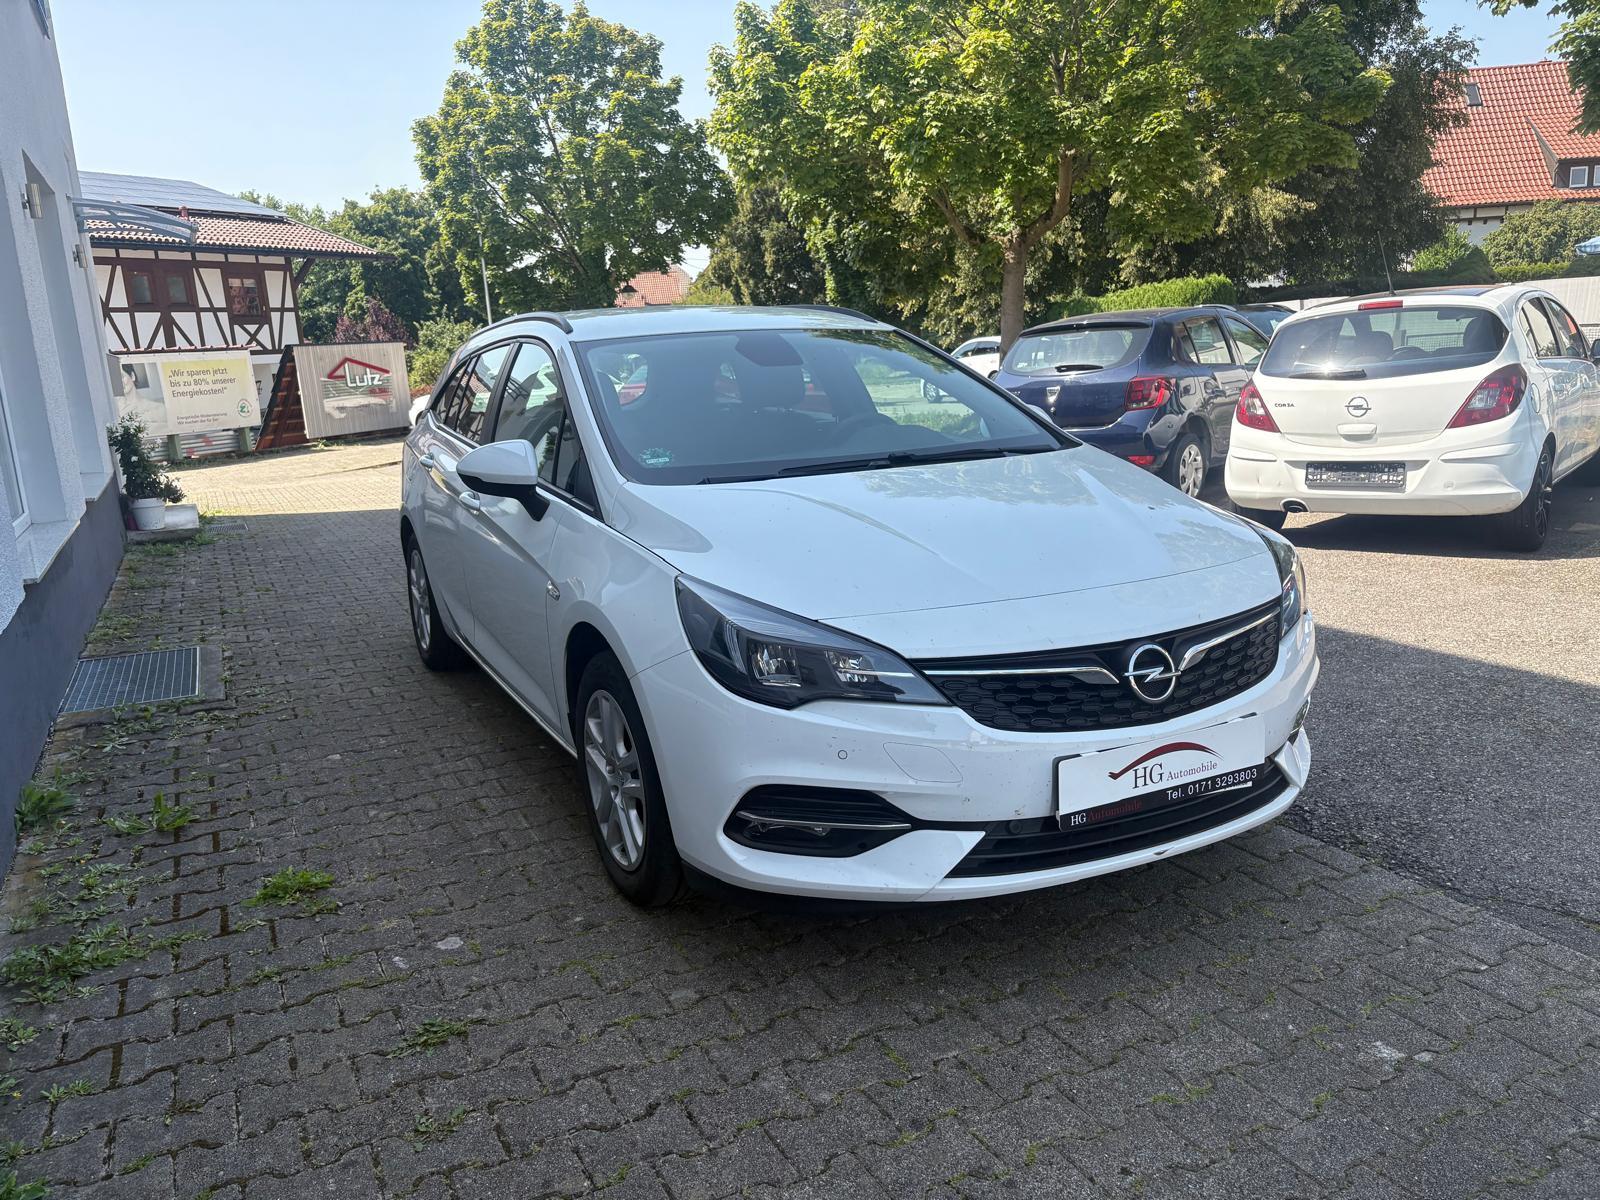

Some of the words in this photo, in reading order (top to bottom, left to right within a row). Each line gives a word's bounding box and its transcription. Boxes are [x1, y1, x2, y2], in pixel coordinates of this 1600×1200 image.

[186, 369, 211, 378] sparen
[212, 367, 228, 376] jetzt
[344, 363, 382, 387] Lutz
[169, 379, 181, 388] bis
[193, 378, 210, 386] 80%
[211, 377, 236, 385] unserer
[1132, 762, 1165, 789] HG
[1166, 761, 1218, 781] Automobile
[1166, 788, 1185, 800] Tel.
[1188, 780, 1212, 795] 0171
[1215, 768, 1257, 788] 3293803
[1070, 812, 1087, 826] HG
